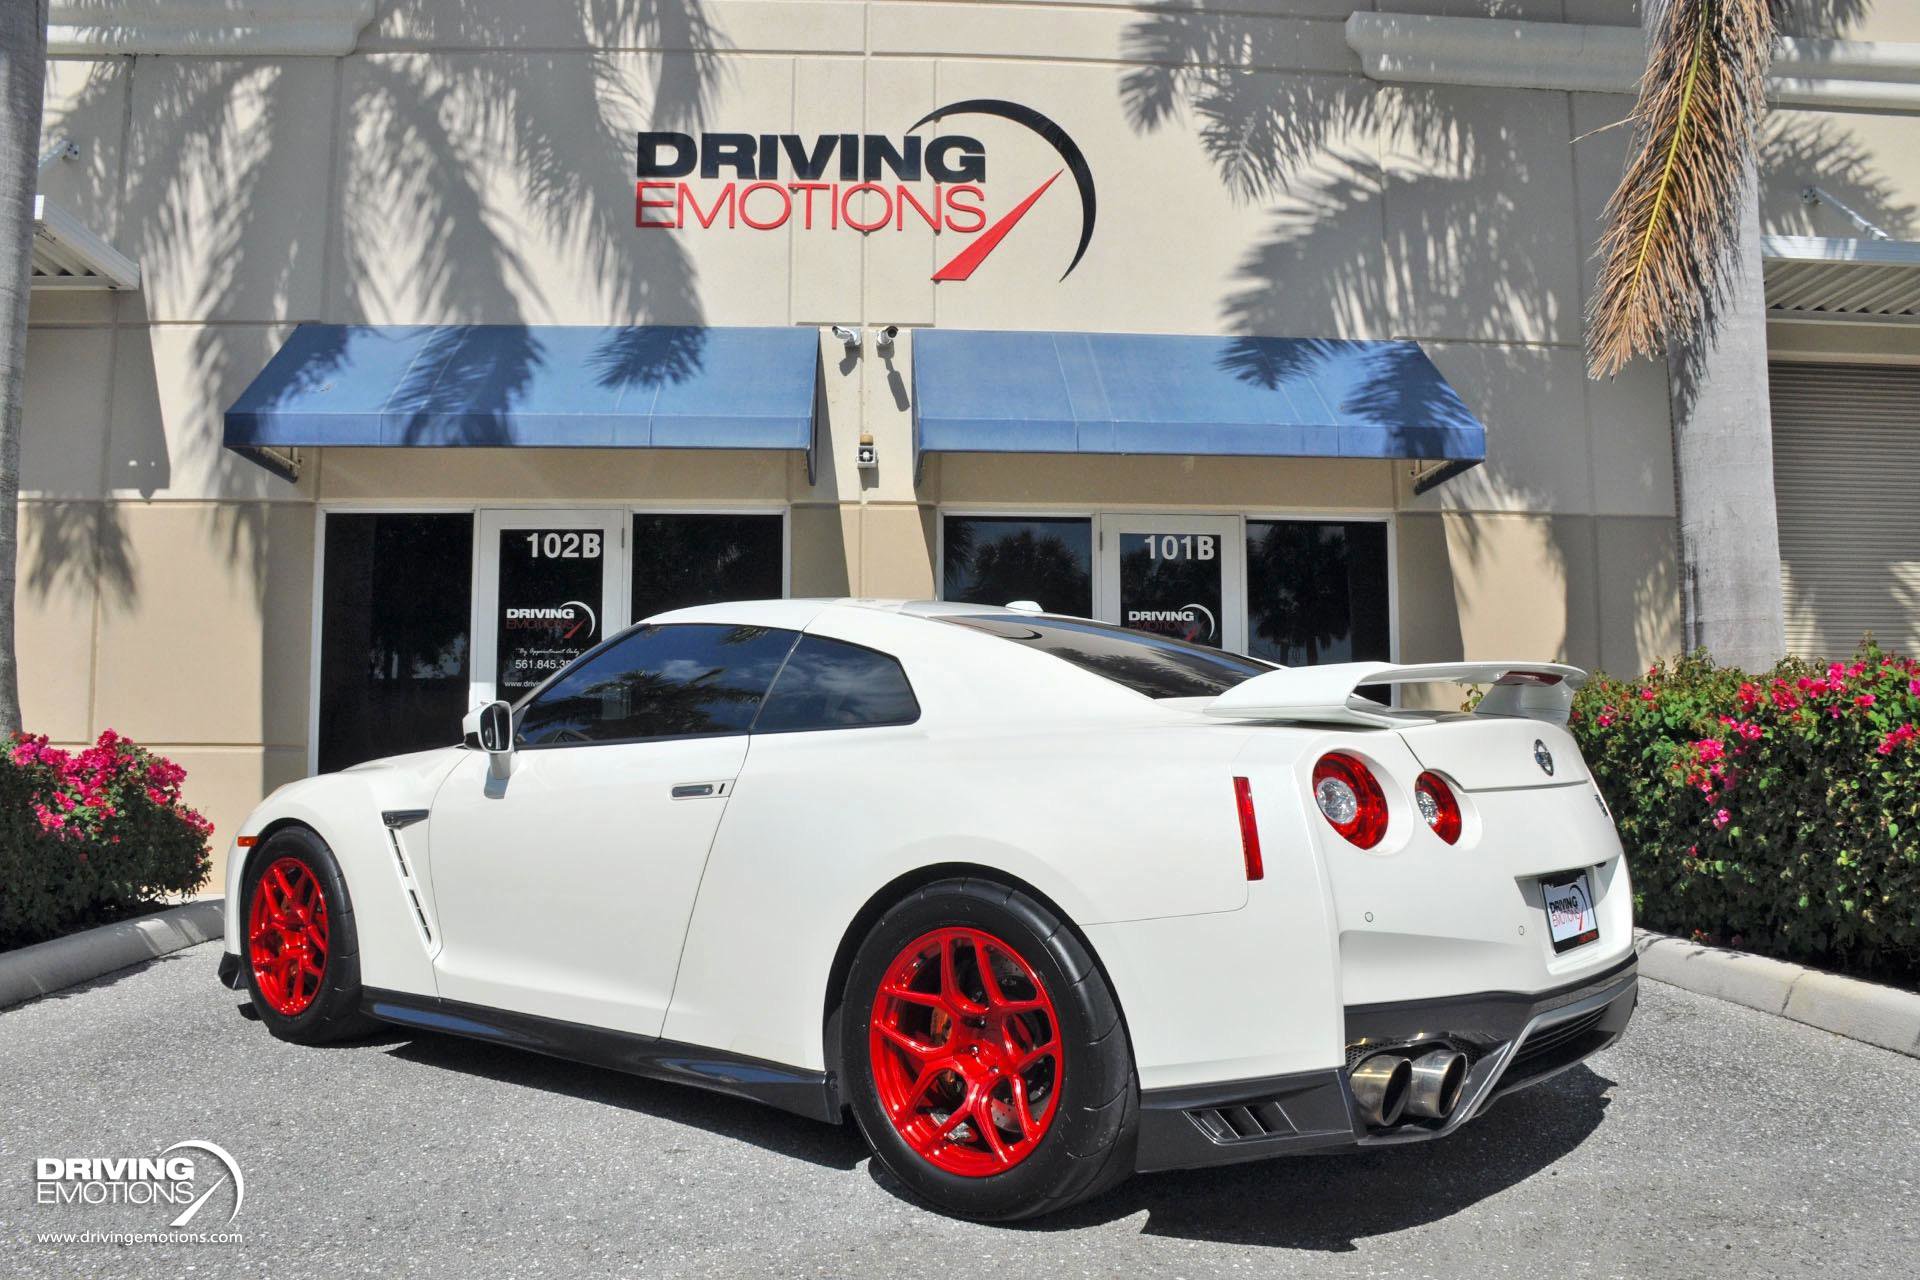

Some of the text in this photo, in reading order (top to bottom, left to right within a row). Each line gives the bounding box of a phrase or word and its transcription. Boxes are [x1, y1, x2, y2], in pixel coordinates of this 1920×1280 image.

[637, 131, 986, 183] DRIVING
[635, 181, 987, 234] EMOTIONS
[526, 532, 601, 558] 102B
[1144, 535, 1215, 561] 101B
[506, 608, 575, 619] DRIVING
[1128, 610, 1194, 622] DRIVING
[1549, 896, 1578, 914] DRIVING
